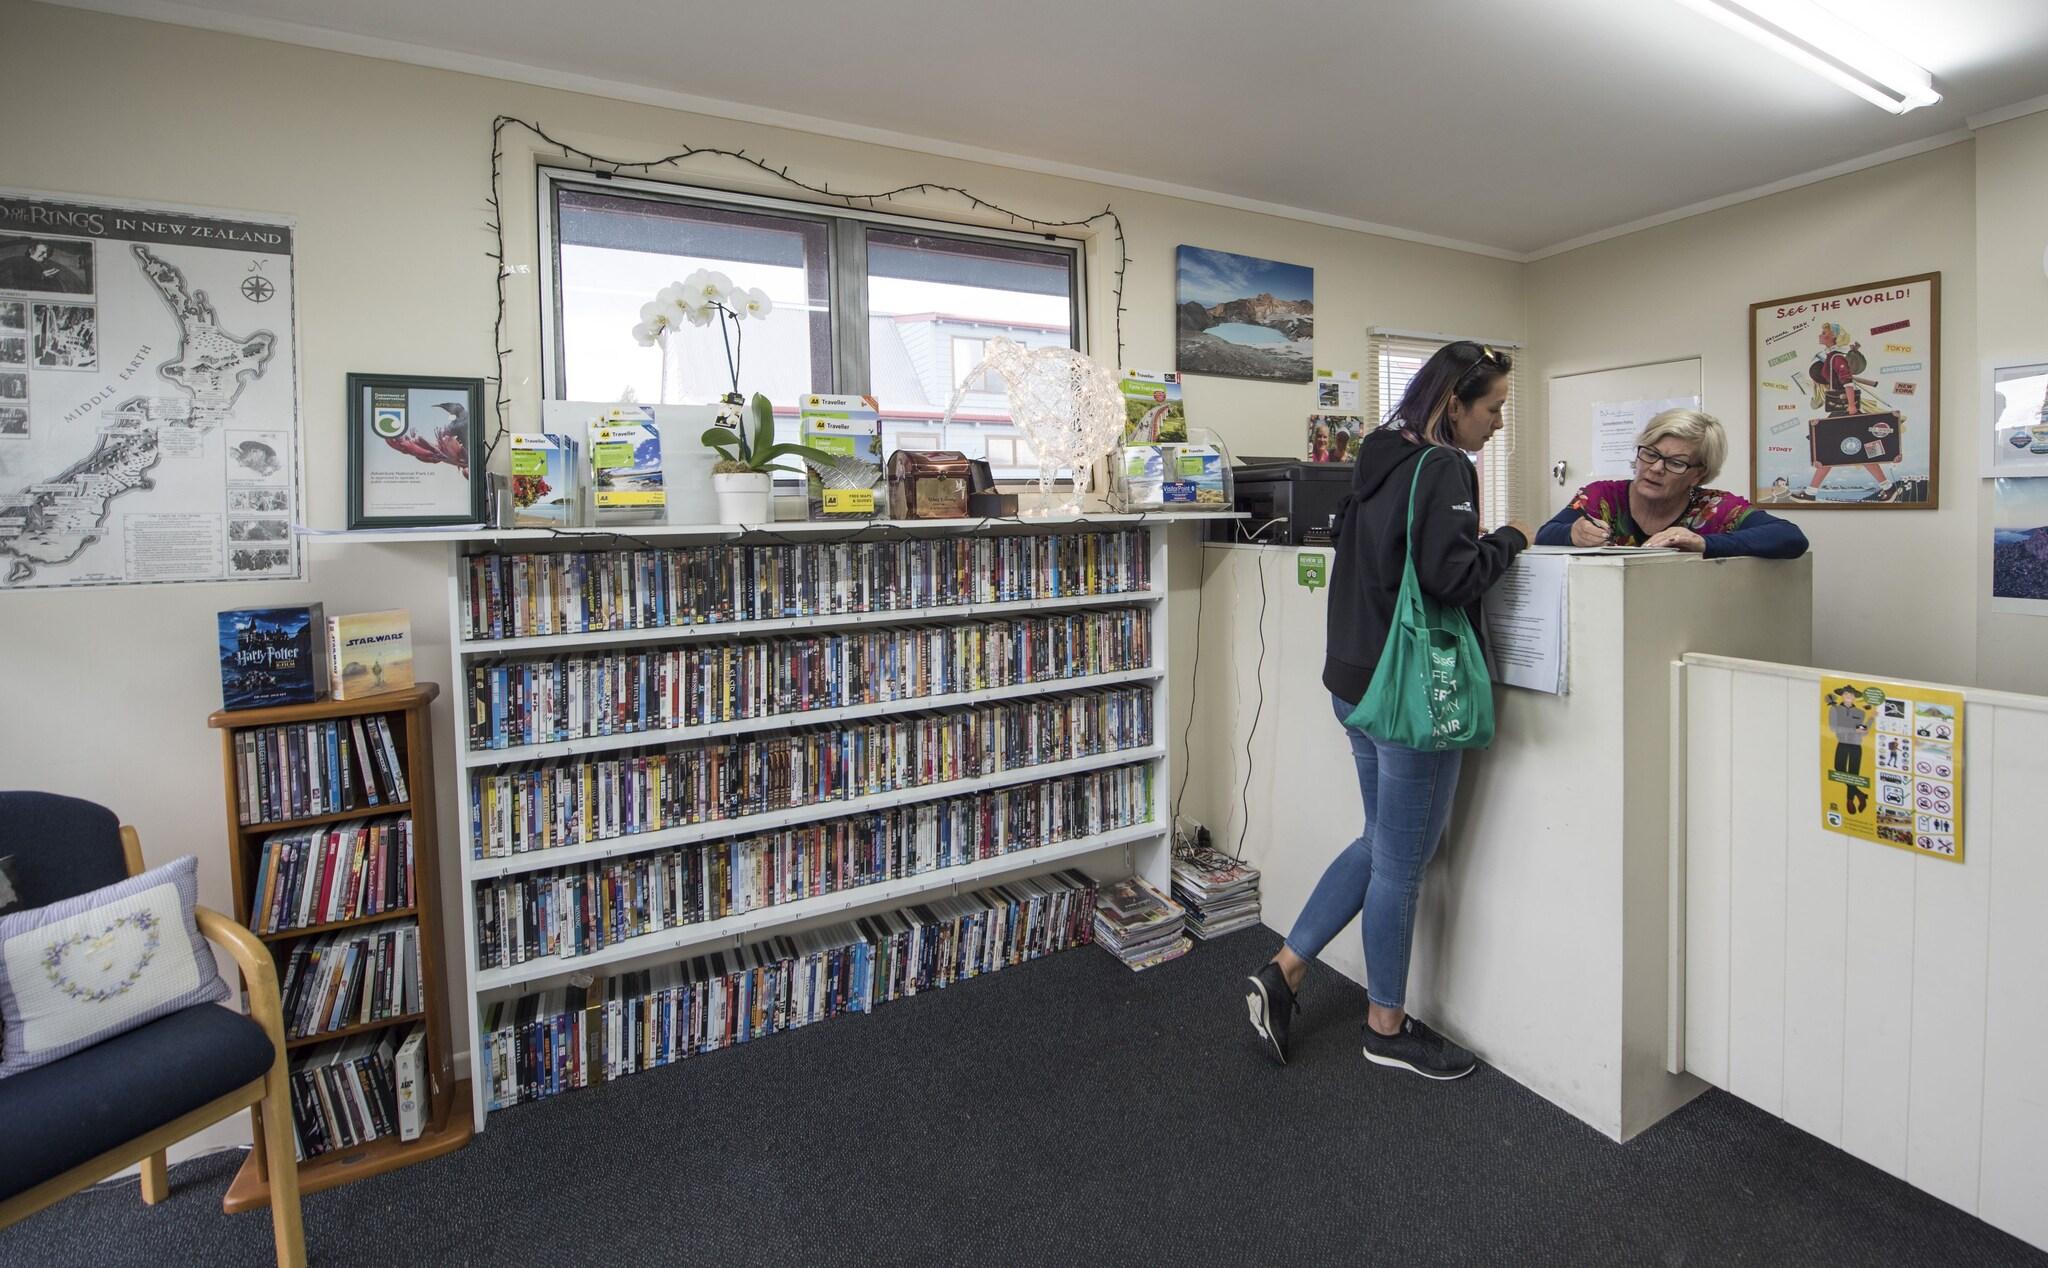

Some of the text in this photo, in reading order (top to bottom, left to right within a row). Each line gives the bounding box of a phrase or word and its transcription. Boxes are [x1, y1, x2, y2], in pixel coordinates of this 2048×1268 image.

[31, 206, 105, 235] RINGS
[115, 218, 137, 232] IN
[142, 221, 186, 236] NEW
[191, 225, 282, 244] ZEALAND
[1776, 288, 1911, 319] SEE THE WORLD!
[1886, 344, 1912, 353] TOKYO
[64, 384, 117, 424] MIDDLE
[119, 344, 152, 381] EARTH
[827, 422, 849, 430] Traveller
[346, 632, 404, 647] STAR WARS
[236, 646, 299, 667] Harry Potter
[367, 885, 375, 909] Adventure
